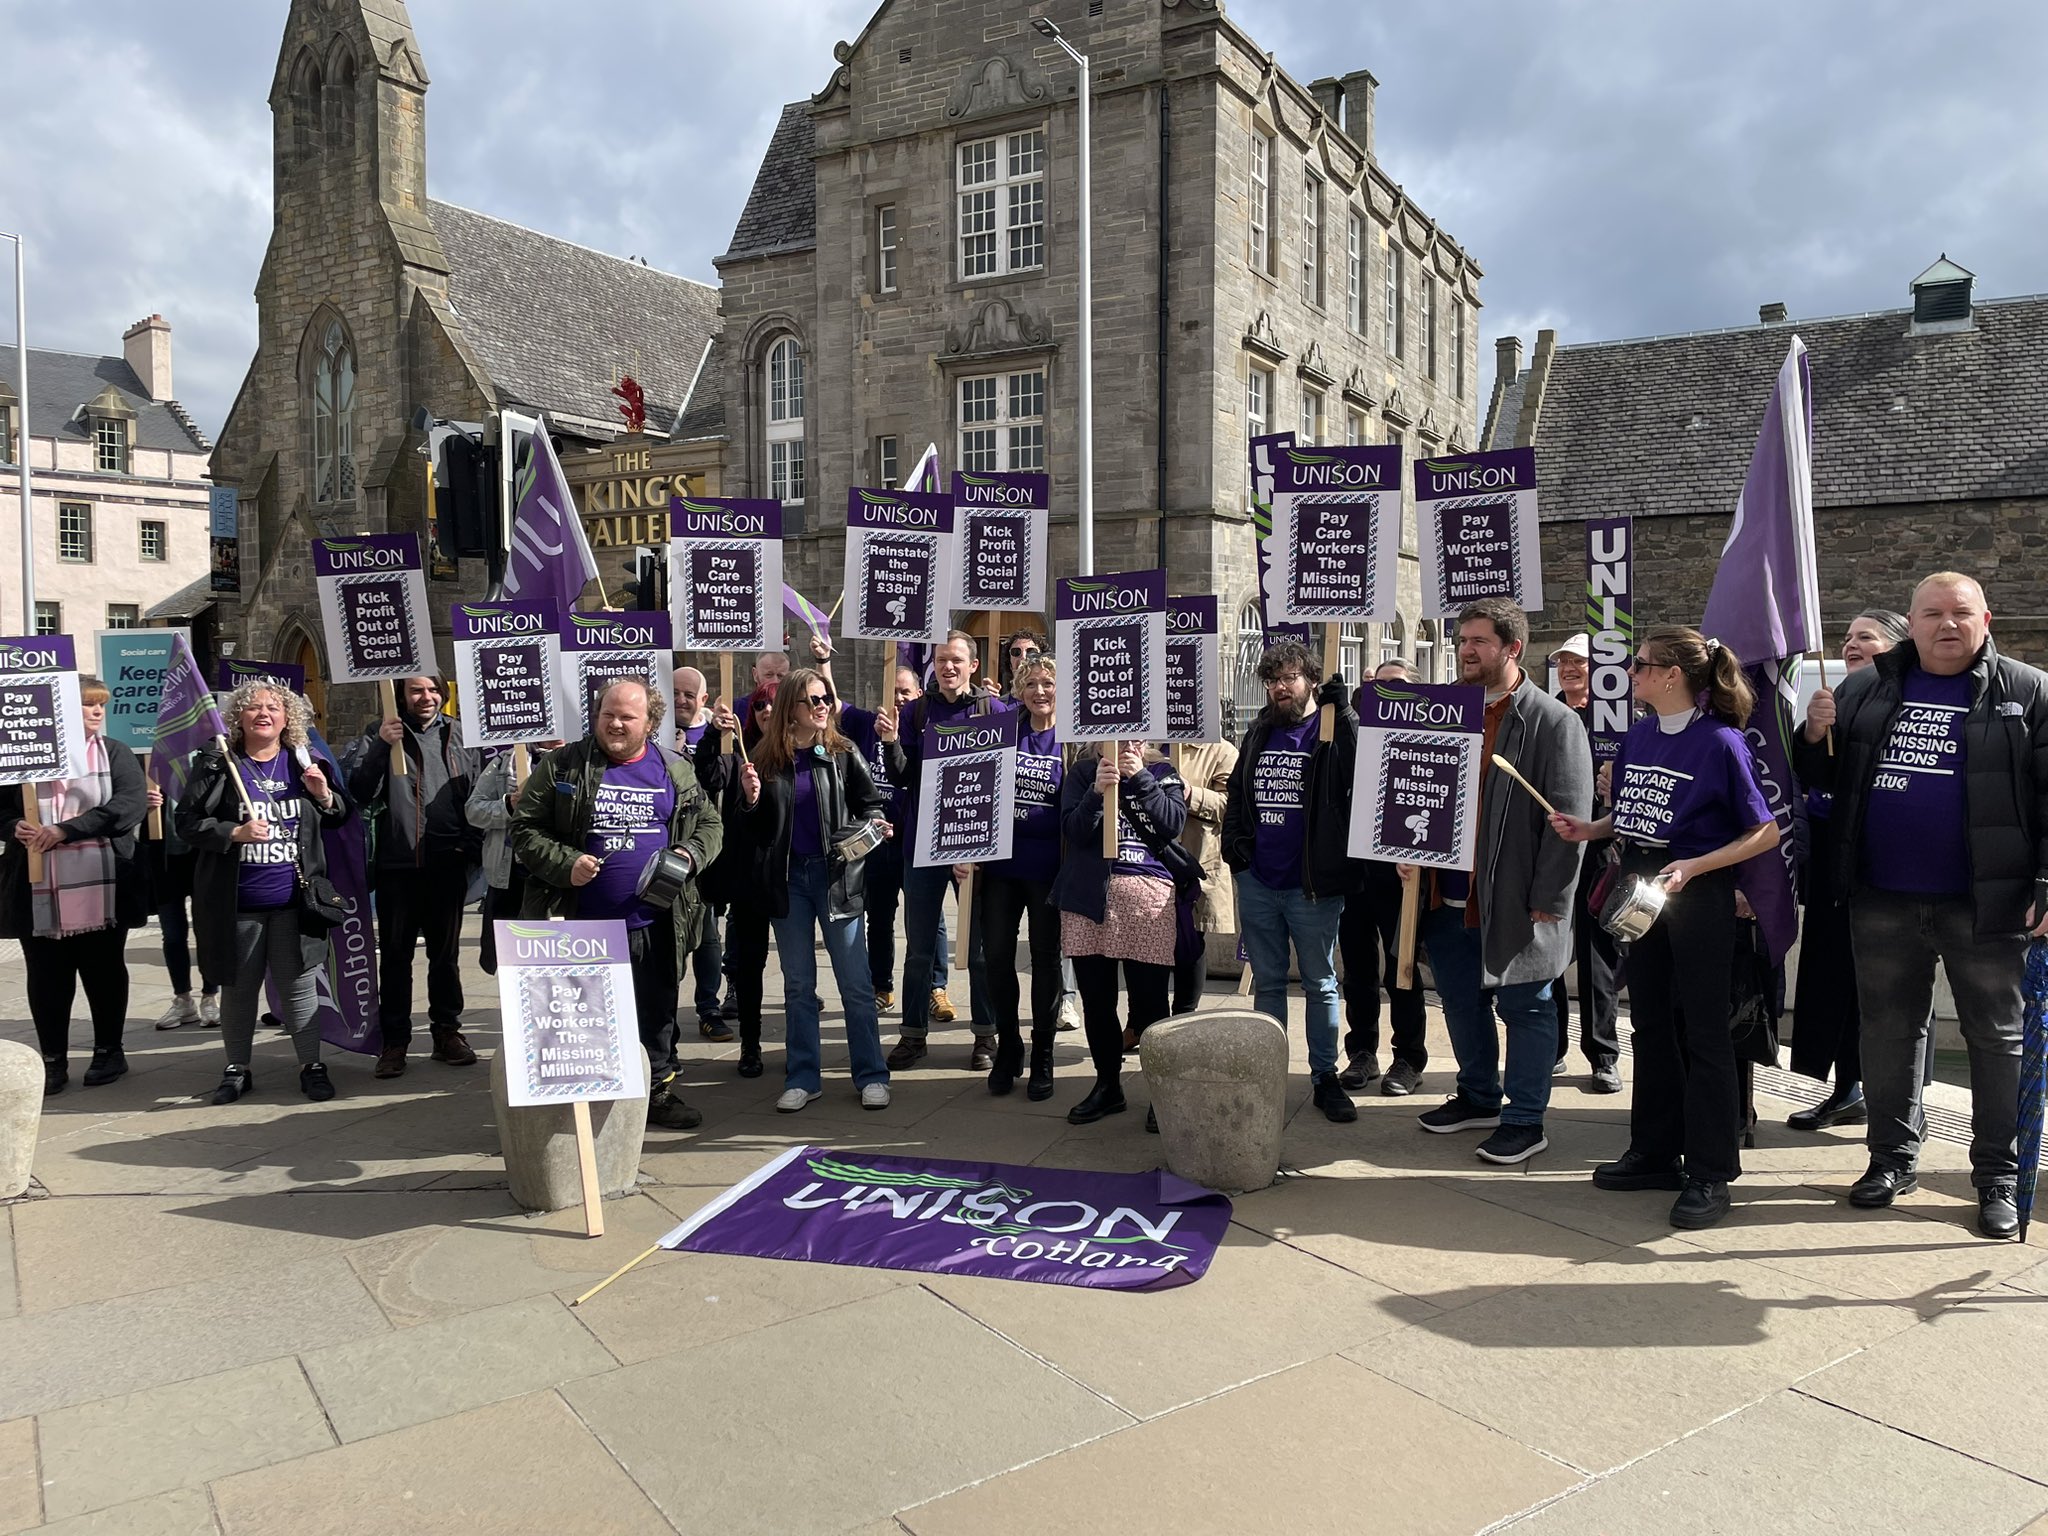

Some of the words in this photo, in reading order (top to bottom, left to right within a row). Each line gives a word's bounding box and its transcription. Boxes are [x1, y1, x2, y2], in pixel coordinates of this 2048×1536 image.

[615, 450, 651, 472] THE
[1292, 464, 1381, 485] UNISON
[1433, 466, 1515, 492] UNISON
[584, 474, 688, 513] KING'S
[965, 486, 1032, 502] UNISON
[864, 505, 937, 525] UNISON
[1320, 512, 1349, 526] Pay
[1462, 515, 1489, 526] Pay
[687, 514, 764, 531] UNISON
[586, 513, 671, 547] ALLE
[984, 526, 1012, 537] Kick
[1316, 527, 1352, 539] Care
[1460, 529, 1494, 540] Care
[980, 539, 1015, 550] Profit
[1301, 543, 1365, 555] Workers
[1447, 541, 1508, 555] Workers
[330, 549, 404, 568] UNISON
[870, 545, 929, 559] Reinstate
[978, 553, 1001, 563] Out
[1004, 553, 1017, 563] of
[711, 557, 736, 569] Pay
[889, 559, 908, 569] the
[1318, 558, 1346, 569] The
[1465, 556, 1492, 567] The
[708, 571, 740, 580] Care
[875, 570, 921, 584] Missing
[977, 566, 1017, 577] Social
[1452, 569, 1507, 582] Missing
[979, 579, 1014, 590] Care!
[1302, 572, 1360, 586] Missing
[696, 583, 753, 593] Workers
[877, 584, 917, 595] £38m!
[1300, 587, 1362, 599] Millions!
[1450, 581, 1510, 597] Millions!
[358, 592, 389, 604] Kick
[712, 597, 737, 607] The
[1072, 589, 1147, 612] UNISON
[356, 605, 396, 618] Profit
[700, 609, 750, 622] Missing
[356, 621, 382, 632] Out
[386, 619, 399, 629] of
[469, 614, 543, 633] UNISON
[1166, 612, 1202, 629] SON
[698, 623, 752, 633] Millions!
[1591, 527, 1629, 733] UNISON
[358, 633, 402, 646] Social
[577, 627, 653, 644] UNISON
[1270, 634, 1304, 645] UNISON
[1094, 637, 1126, 651] Kick
[0, 650, 57, 669] ISON
[364, 647, 401, 659] Care!
[499, 654, 523, 665] Pay
[1166, 653, 1181, 665] ay
[1090, 653, 1131, 667] Profit
[496, 666, 527, 675] Care
[587, 665, 648, 675] Reinstate
[1088, 670, 1115, 683] Out
[1118, 668, 1133, 681] of
[1166, 666, 1183, 674] are
[485, 678, 540, 689] Workers
[1166, 678, 1194, 687] rkers
[502, 691, 526, 700] The
[1088, 684, 1133, 699] Social
[1167, 691, 1181, 700] he
[4, 692, 33, 705] Pay
[1, 705, 38, 716] Care
[113, 700, 130, 714] in
[490, 702, 540, 713] Missing
[1091, 701, 1131, 716] Care!
[1167, 703, 1192, 713] sing
[1377, 701, 1463, 724] UNISON
[490, 712, 543, 726] Millions!
[1168, 715, 1194, 724] ions!
[1910, 710, 1954, 722] CARE
[7, 730, 37, 741] The
[1892, 722, 1949, 736] RKERS
[938, 728, 1002, 751] UNISON
[1890, 735, 1957, 754] MISSING
[1595, 742, 1621, 751] UNISO
[1258, 756, 1276, 765] PAY
[1277, 757, 1302, 767] CARE
[1390, 748, 1458, 765] Reinstate
[1880, 750, 1938, 766] ILLIONS
[1025, 758, 1053, 769] CARE
[959, 772, 980, 782] Pay
[1015, 766, 1051, 780] RKERS
[1255, 768, 1301, 779] WORKERS
[1411, 765, 1434, 777] the
[1254, 779, 1265, 789] HE
[1394, 778, 1449, 797] Missing
[1624, 771, 1647, 785] PAY
[1645, 773, 1676, 791] ARE
[955, 784, 981, 794] Care
[1015, 789, 1045, 801] LIONS
[596, 789, 618, 801] PAY
[621, 792, 654, 803] CARE
[943, 794, 991, 808] Workers
[1395, 793, 1444, 809] £38m!
[1620, 787, 1670, 805] WOKERS
[594, 801, 654, 816] WORKERS
[956, 808, 976, 818] The
[1631, 803, 1673, 823] SSING
[944, 821, 988, 833] Missing
[941, 832, 989, 846] Millions!
[240, 842, 297, 863] NISO
[517, 939, 607, 958] UNISON
[552, 986, 582, 999] Pay
[549, 1001, 588, 1013] Care
[535, 1017, 604, 1029] Workers
[556, 1032, 587, 1044] The
[542, 1048, 604, 1061] Missing
[541, 1063, 608, 1077] Millions!
[783, 1182, 1183, 1243] UNISON
